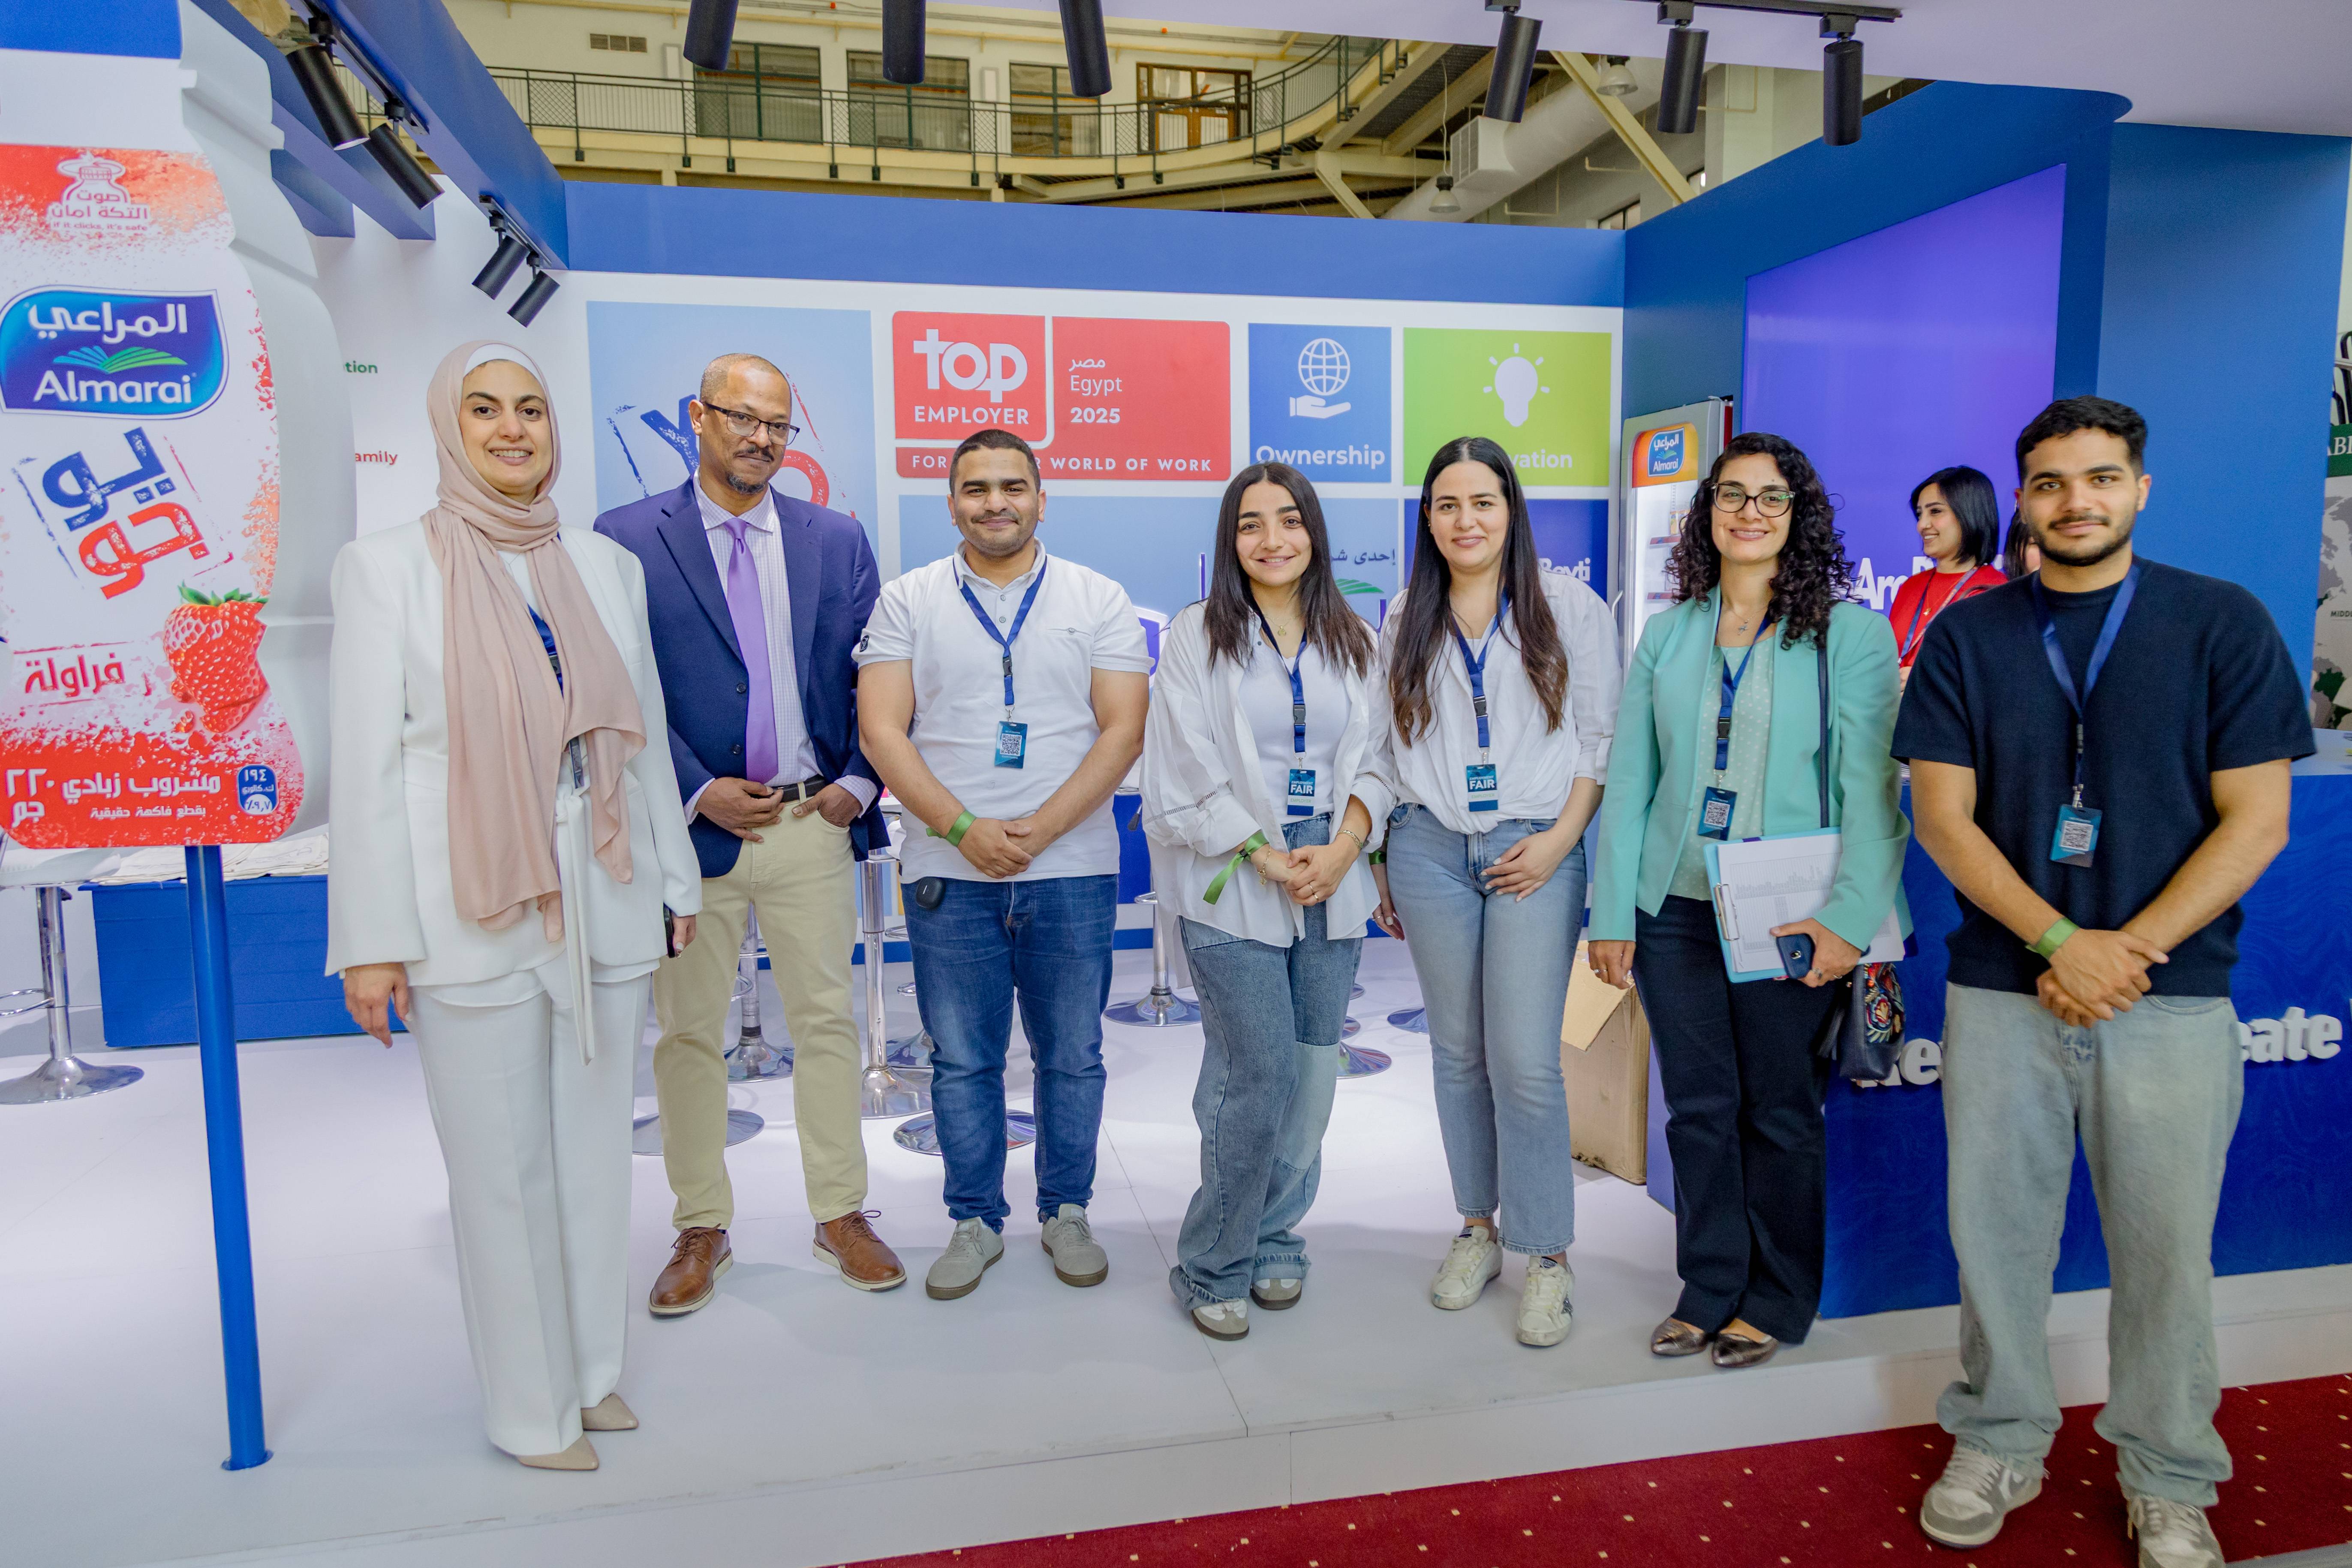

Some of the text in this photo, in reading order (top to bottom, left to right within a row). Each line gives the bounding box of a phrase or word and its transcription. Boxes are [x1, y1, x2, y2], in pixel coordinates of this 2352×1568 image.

[77, 190, 120, 204] صوت
[28, 302, 188, 344] المراعي
[344, 360, 378, 373] tion
[913, 328, 1028, 403] top
[1069, 356, 1106, 372] مصر
[33, 370, 192, 403] Almarai
[1071, 375, 1123, 397] Egypt
[914, 406, 1029, 425] EMPLOYER
[1070, 407, 1121, 424] 2025
[1654, 433, 1679, 451] المراعي
[355, 450, 398, 465] amily
[912, 455, 947, 468] FOR
[1050, 457, 1116, 471] WORLD
[1126, 458, 1149, 471] OF
[1158, 458, 1212, 472] WORK
[1256, 444, 1385, 469] Ownership
[1509, 448, 1573, 468] vation
[1653, 458, 1678, 472] Almarai
[1354, 548, 1396, 566] إحدى
[25, 653, 125, 698] فراولة
[62, 767, 221, 804] مشروب زبادي
[1290, 784, 1313, 794] FAIR
[1469, 779, 1495, 790] FAIR
[11, 801, 45, 828] جم
[90, 806, 131, 820] حقيقية
[135, 805, 172, 817] فاكهة
